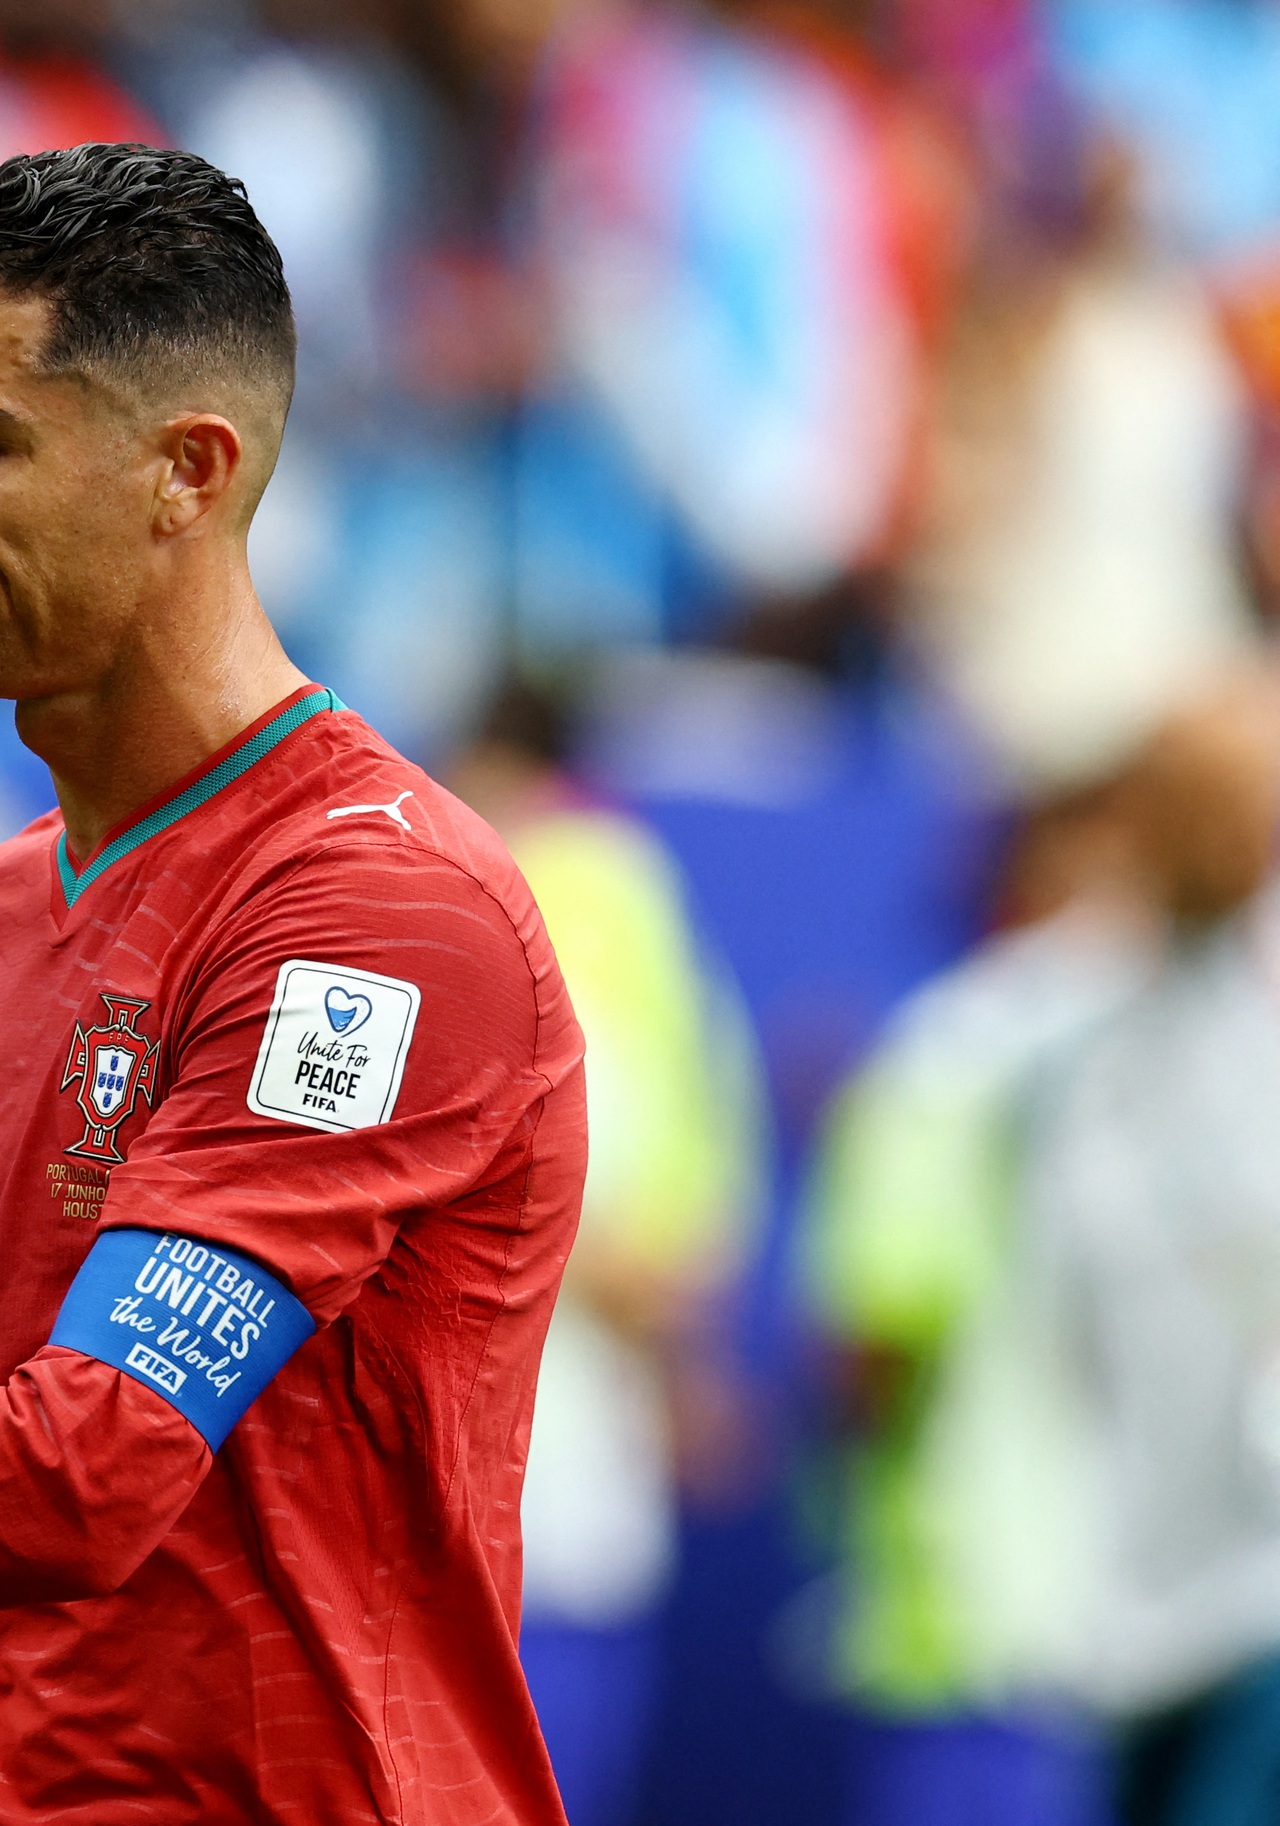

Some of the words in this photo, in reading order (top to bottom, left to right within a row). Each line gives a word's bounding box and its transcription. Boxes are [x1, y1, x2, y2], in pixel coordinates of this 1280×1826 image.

[297, 1031, 344, 1061] Unite
[345, 1044, 371, 1068] For
[294, 1060, 361, 1099] PEACE
[302, 1093, 337, 1113] FIFA
[46, 1163, 103, 1184] PORTUGAL
[51, 1182, 63, 1198] 17
[65, 1184, 106, 1201] JUNHO
[154, 1231, 275, 1328] FOOTBALL
[134, 1256, 260, 1360] UNITES
[109, 1295, 156, 1333] the
[156, 1316, 242, 1398] World
[131, 1350, 181, 1390] FIFA
